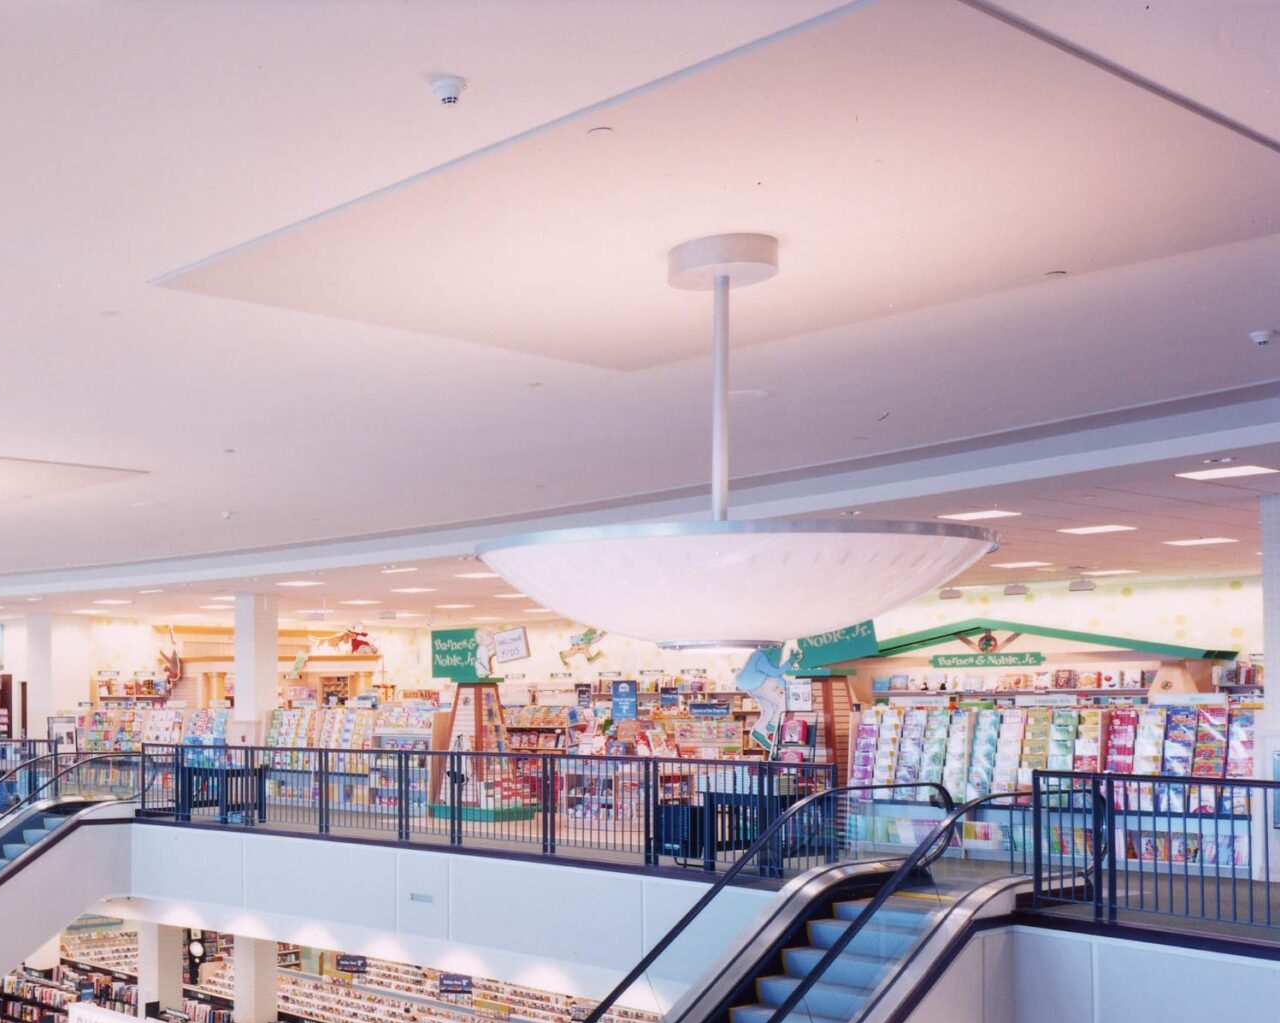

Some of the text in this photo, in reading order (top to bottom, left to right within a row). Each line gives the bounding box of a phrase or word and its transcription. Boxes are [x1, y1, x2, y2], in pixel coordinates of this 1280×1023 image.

[435, 638, 467, 651] Barnes
[501, 647, 520, 657] KIDS
[435, 654, 464, 667] Noble,
[938, 653, 1036, 667] Barnes & Noble, Jr.
